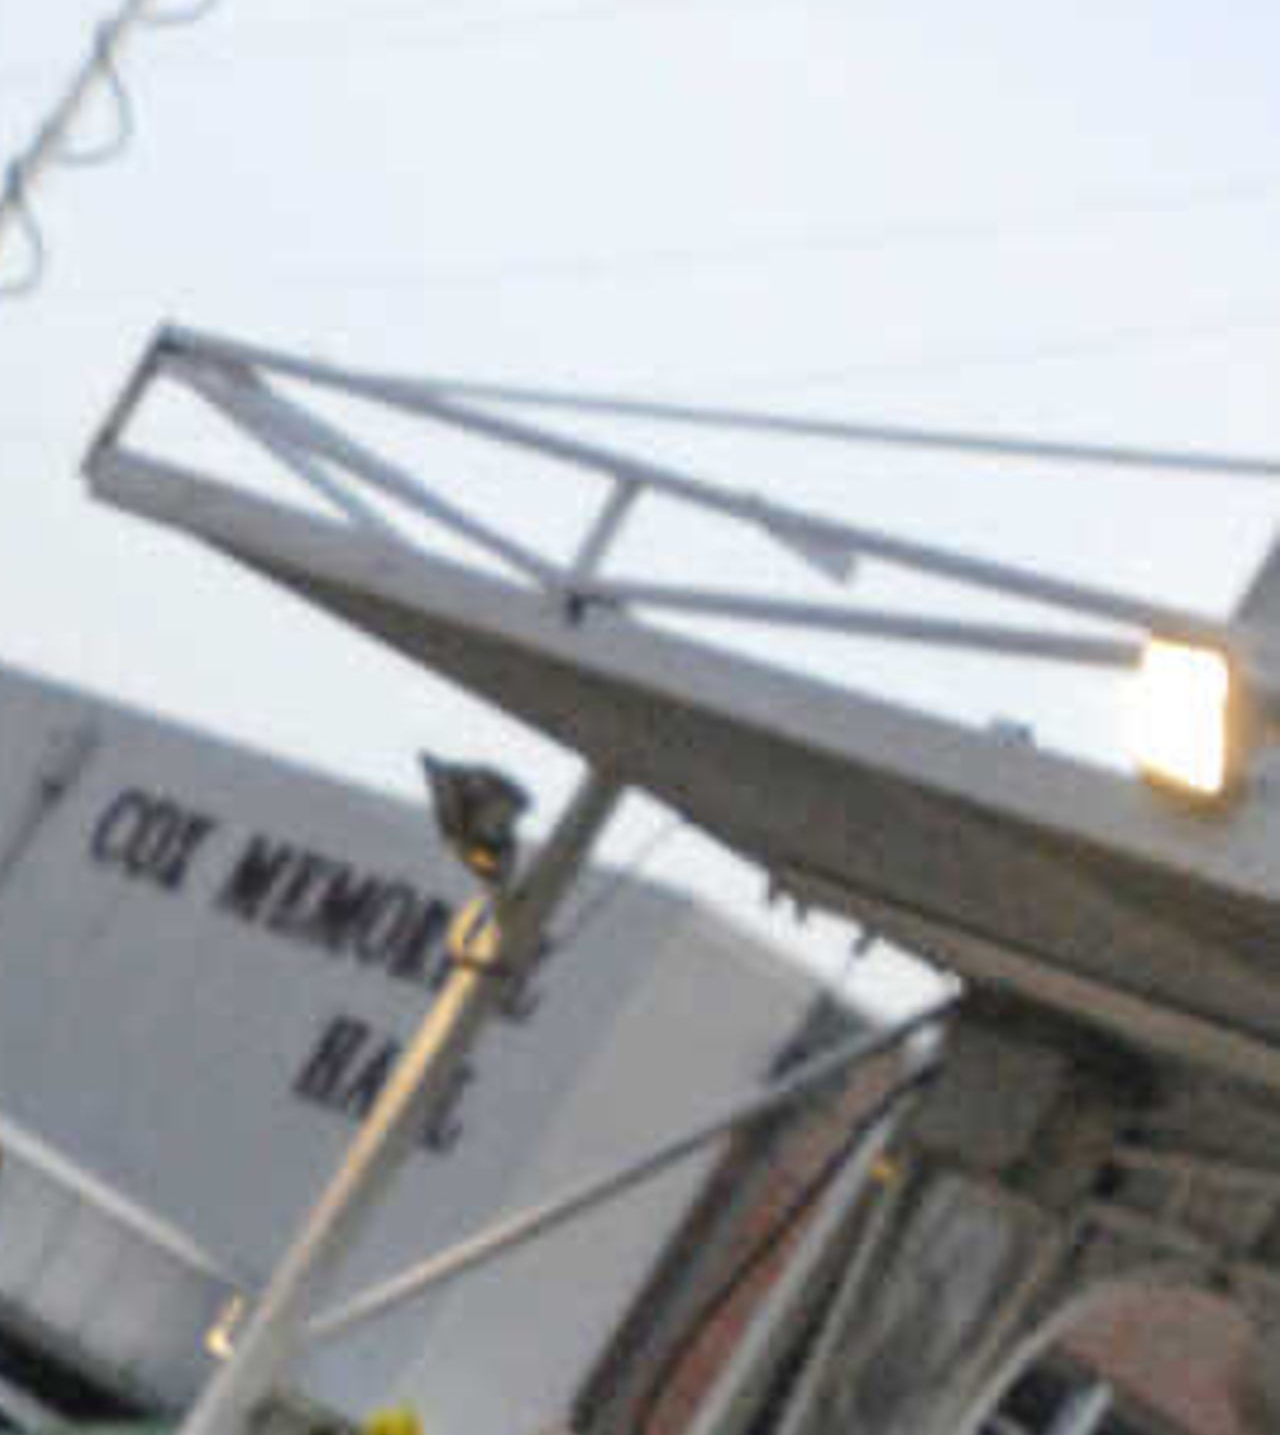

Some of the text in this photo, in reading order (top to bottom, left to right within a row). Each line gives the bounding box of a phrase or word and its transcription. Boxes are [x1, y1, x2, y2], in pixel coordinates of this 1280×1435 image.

[92, 787, 554, 1023] COX MEMORL
[293, 1014, 474, 1153] HAL
